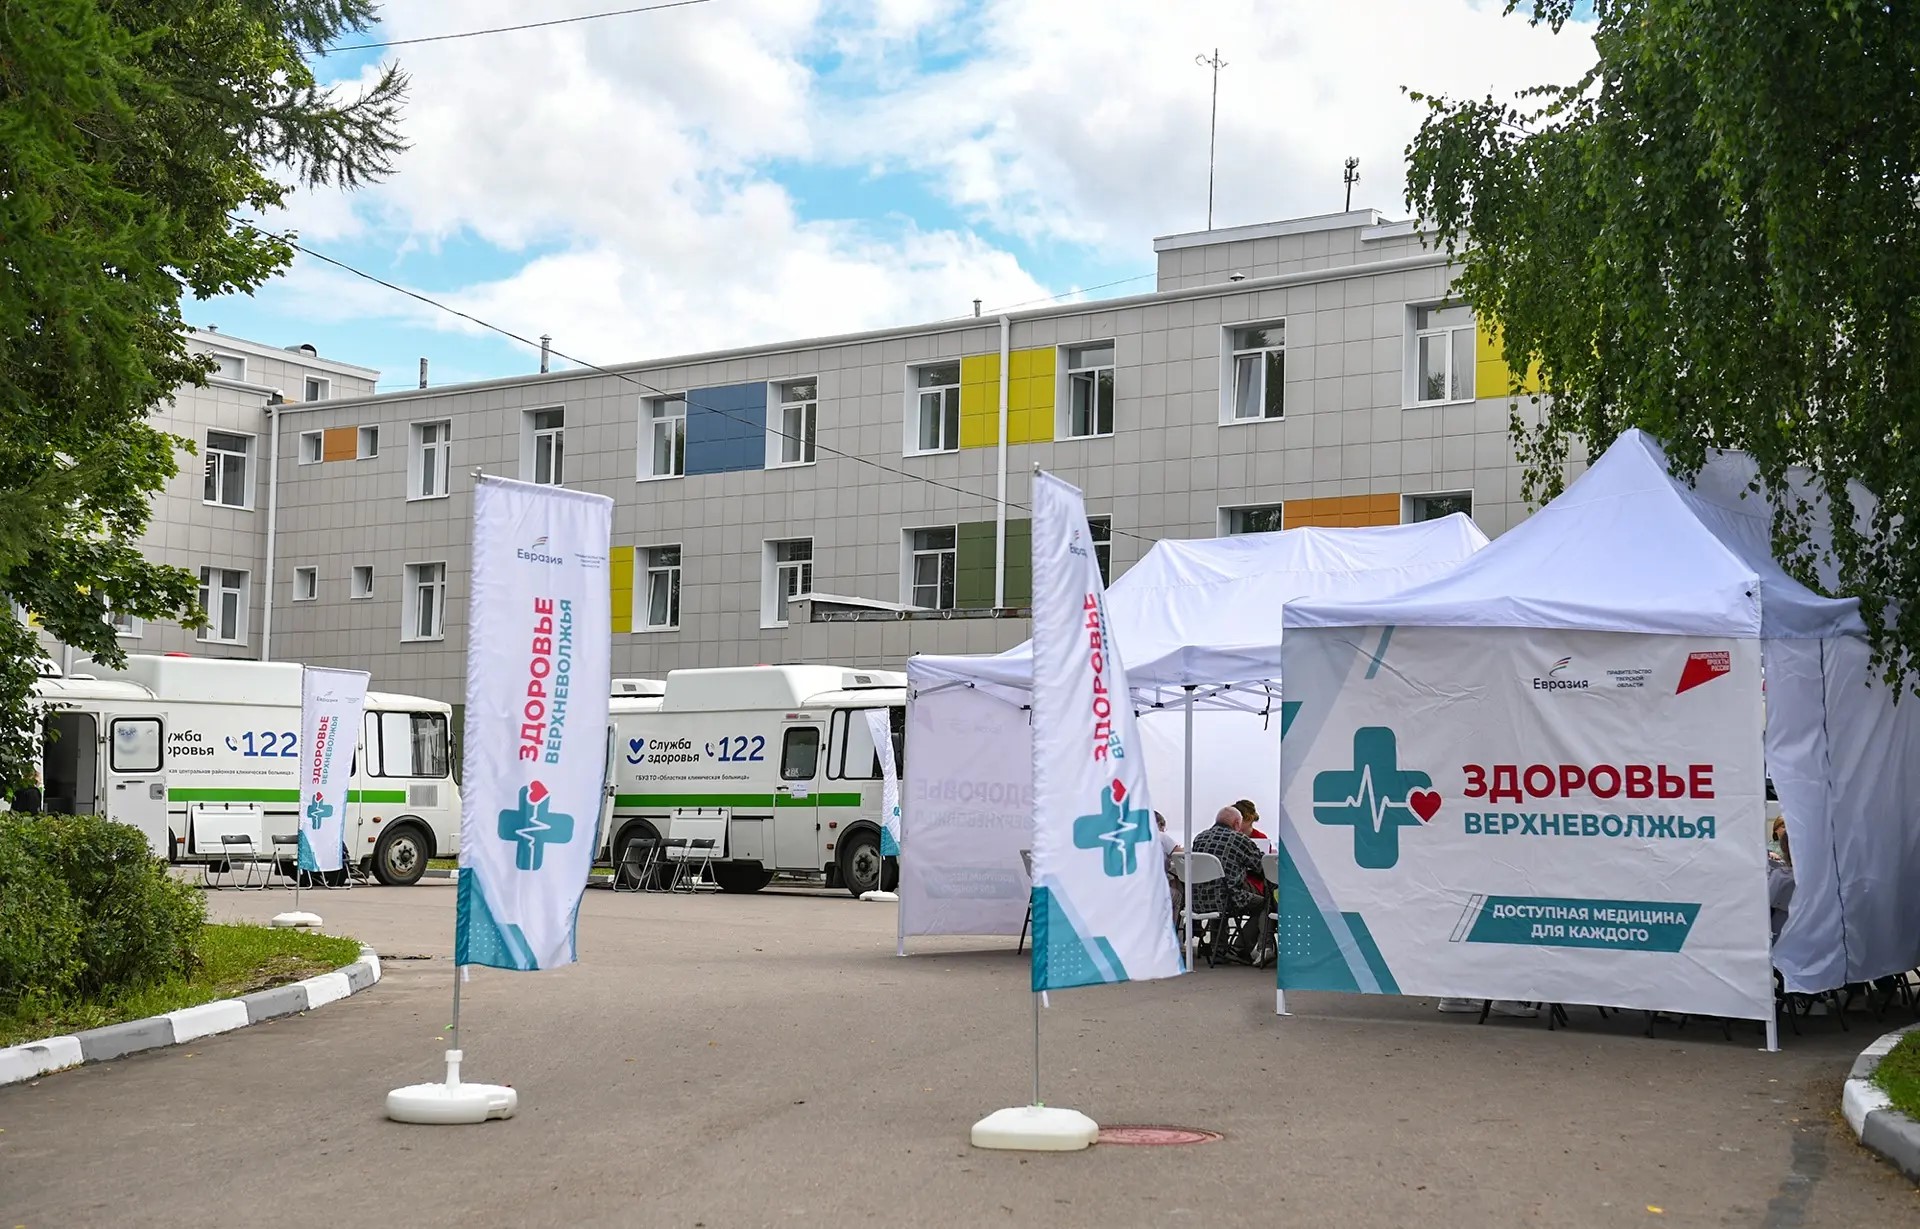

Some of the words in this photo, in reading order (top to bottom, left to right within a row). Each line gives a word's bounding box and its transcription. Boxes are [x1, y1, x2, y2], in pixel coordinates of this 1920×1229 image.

[517, 548, 563, 565] Евразия
[519, 597, 553, 763] ЗДОРОВЬЕ
[544, 599, 572, 764] ВЕРХНЕВОЛЖЬЯ
[1533, 677, 1589, 692] Евразия
[242, 731, 298, 757] 122
[312, 716, 330, 785] ЗДОРОВЬЕ
[321, 716, 339, 785] ВЕРХНЕВОЛЖЬЯ
[649, 738, 692, 752] Служба
[718, 735, 766, 762] 122
[647, 753, 700, 765] здоровья
[1462, 764, 1716, 804] ЗДОРОВЬЕ
[1463, 812, 1717, 839] ВЕРХНЕВОЛЖЬЯ
[1492, 904, 1589, 921] ДОСТУПНАЯ
[1593, 908, 1687, 926] МЕДИЦИНА
[1531, 923, 1565, 939] ДЛЯ
[1569, 926, 1649, 943] КАЖДОГО
